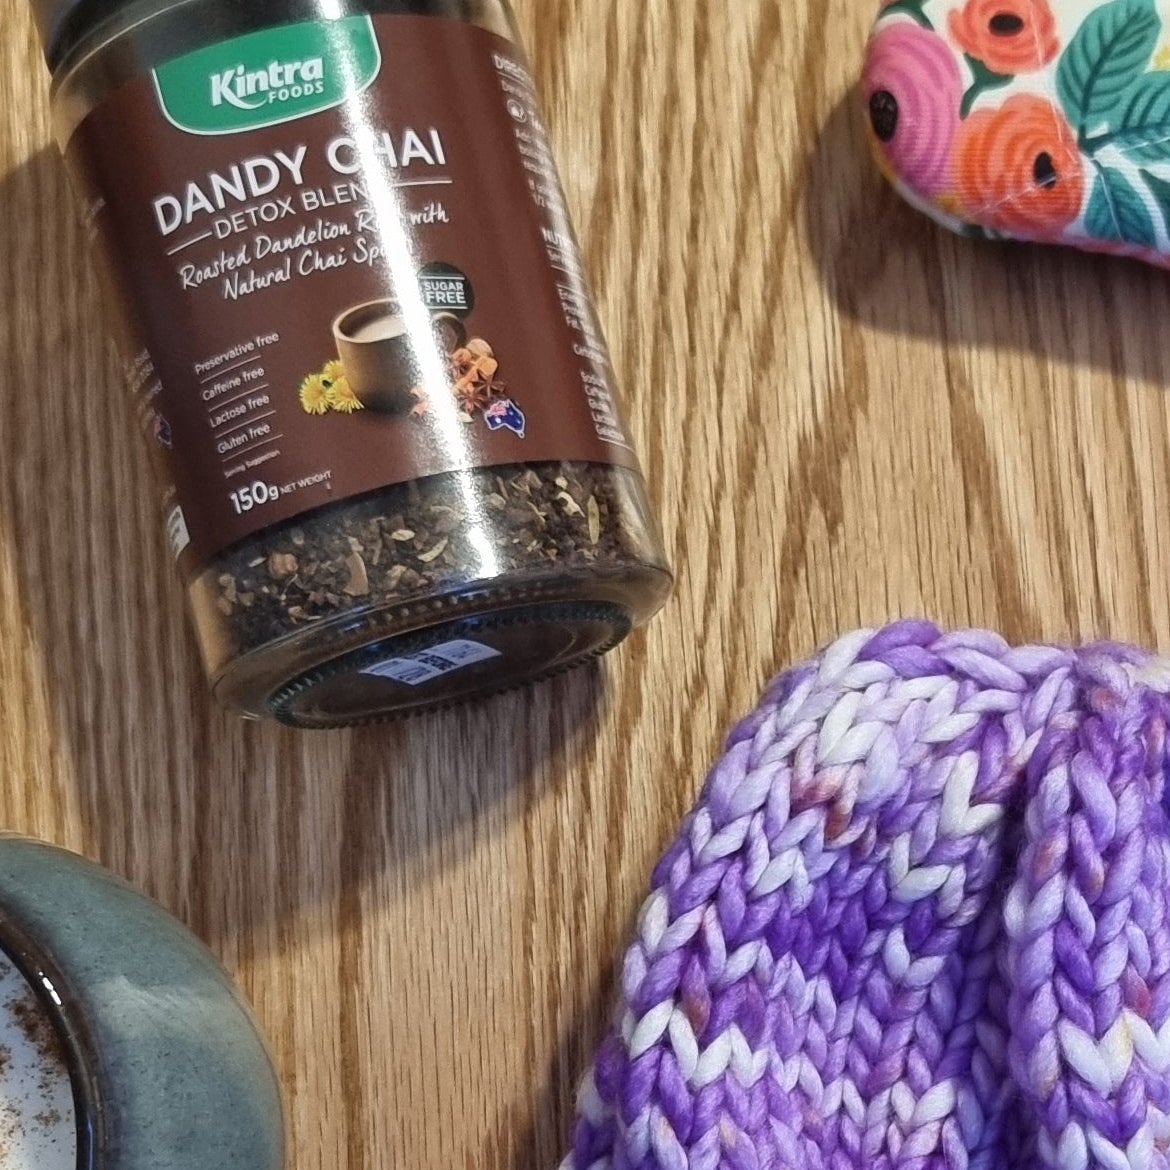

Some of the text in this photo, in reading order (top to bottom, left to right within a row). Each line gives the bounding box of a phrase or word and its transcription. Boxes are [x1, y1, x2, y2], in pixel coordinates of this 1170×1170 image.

[210, 57, 324, 107] Kintra
[268, 81, 324, 104] FOODS
[154, 145, 307, 236] DANDY
[215, 181, 376, 240] DETOX BLEN
[180, 245, 251, 289] Roasted
[255, 219, 351, 259] Dandelion
[410, 202, 450, 225] with
[224, 257, 291, 300] Natural
[299, 248, 347, 276] Chai
[424, 281, 464, 292] SUGAR
[426, 291, 466, 304] FREE
[194, 332, 280, 374] Preservative free
[202, 366, 265, 401] Caffeine free
[210, 394, 270, 428] Lactose free
[217, 423, 271, 454] Gluten free
[230, 480, 279, 514] 150g
